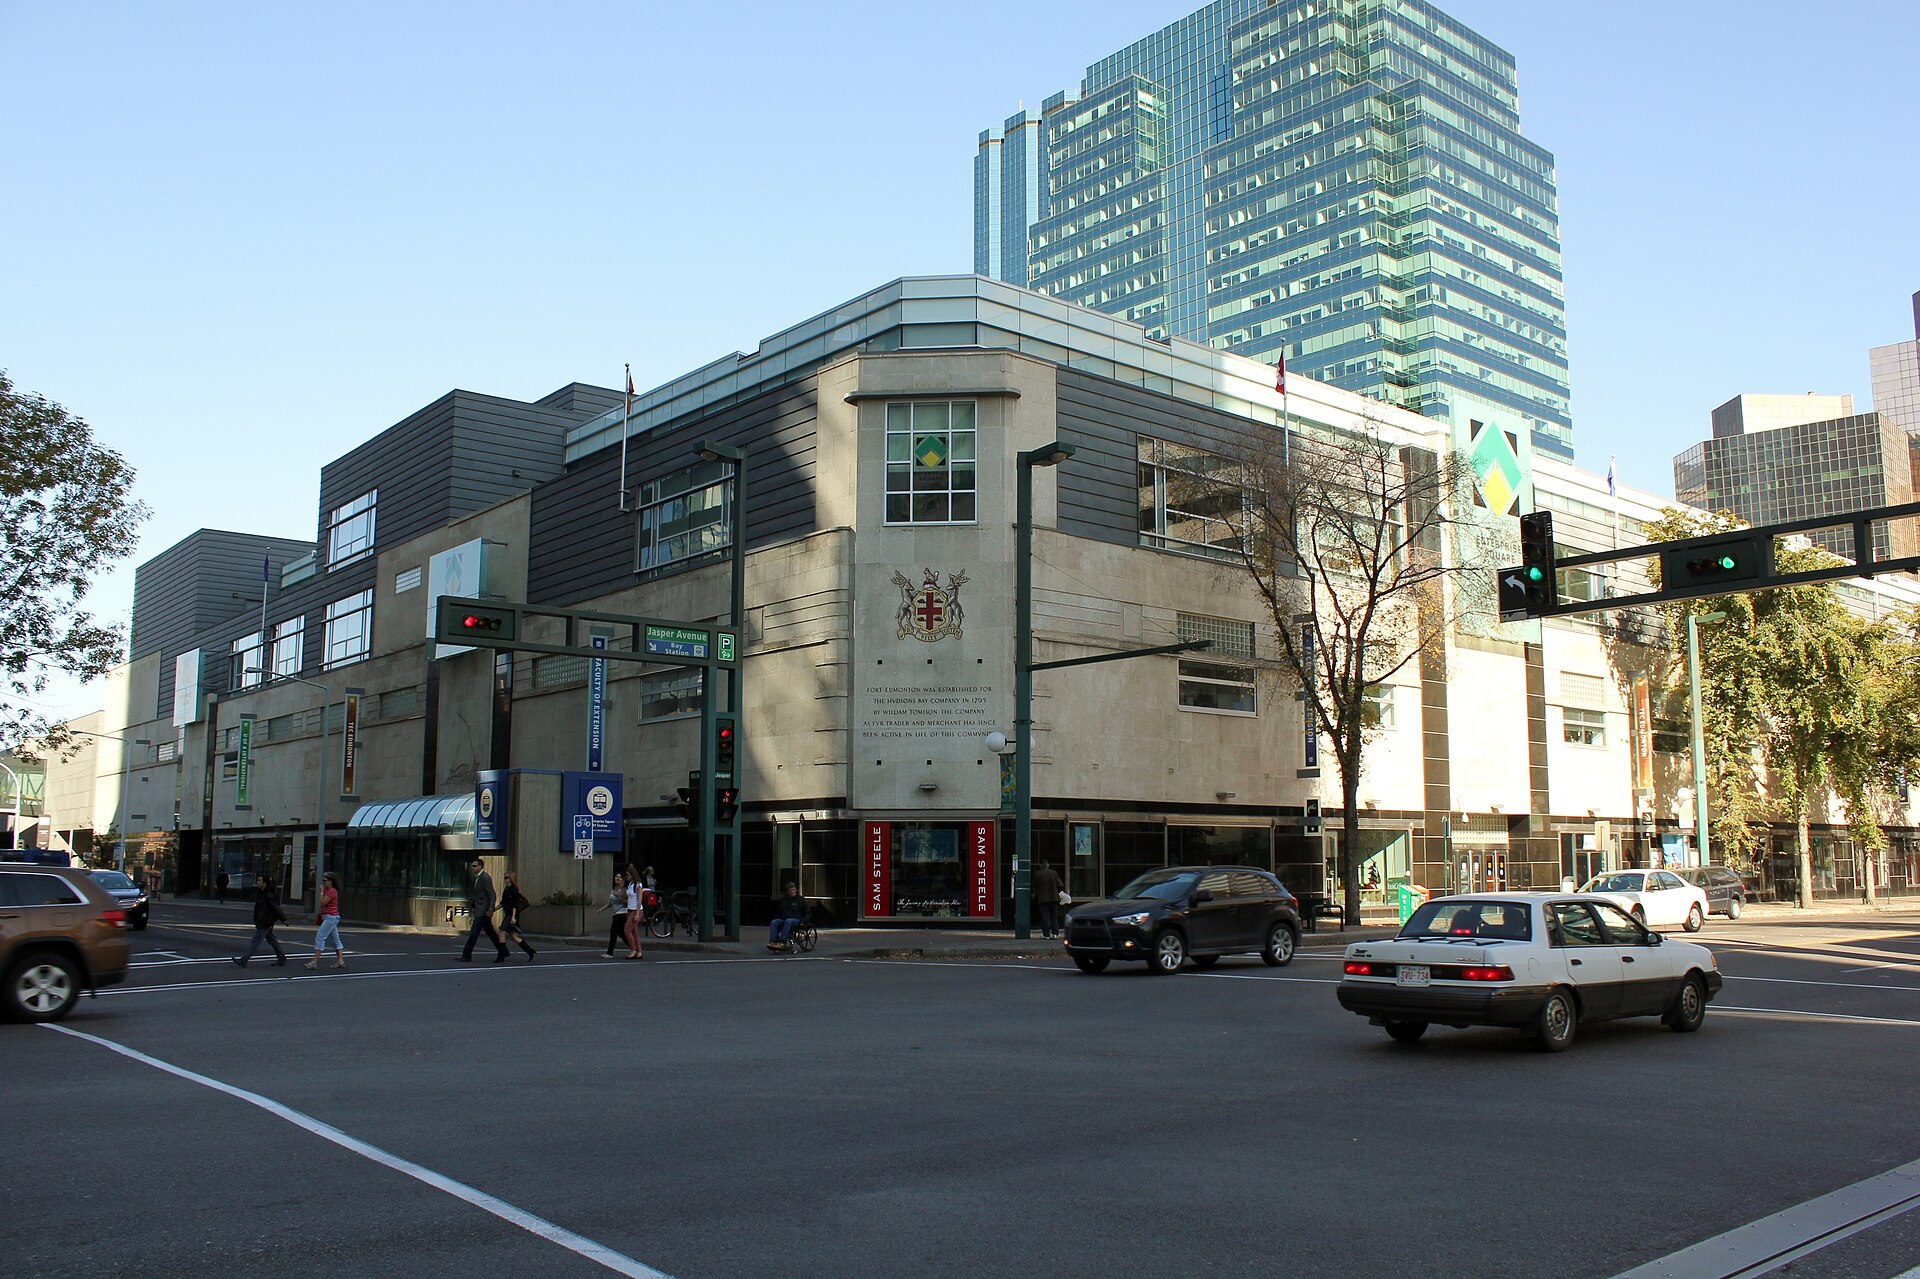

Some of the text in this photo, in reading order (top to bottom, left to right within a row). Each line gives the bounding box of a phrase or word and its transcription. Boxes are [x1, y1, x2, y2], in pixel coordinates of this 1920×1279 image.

[1476, 536, 1521, 554] ENTERPRISE
[1484, 549, 1516, 564] SQUARE
[648, 627, 707, 641] Jasper Avenue
[594, 693, 600, 703] OF
[978, 860, 986, 911] STEELE
[873, 883, 881, 911] SAM
